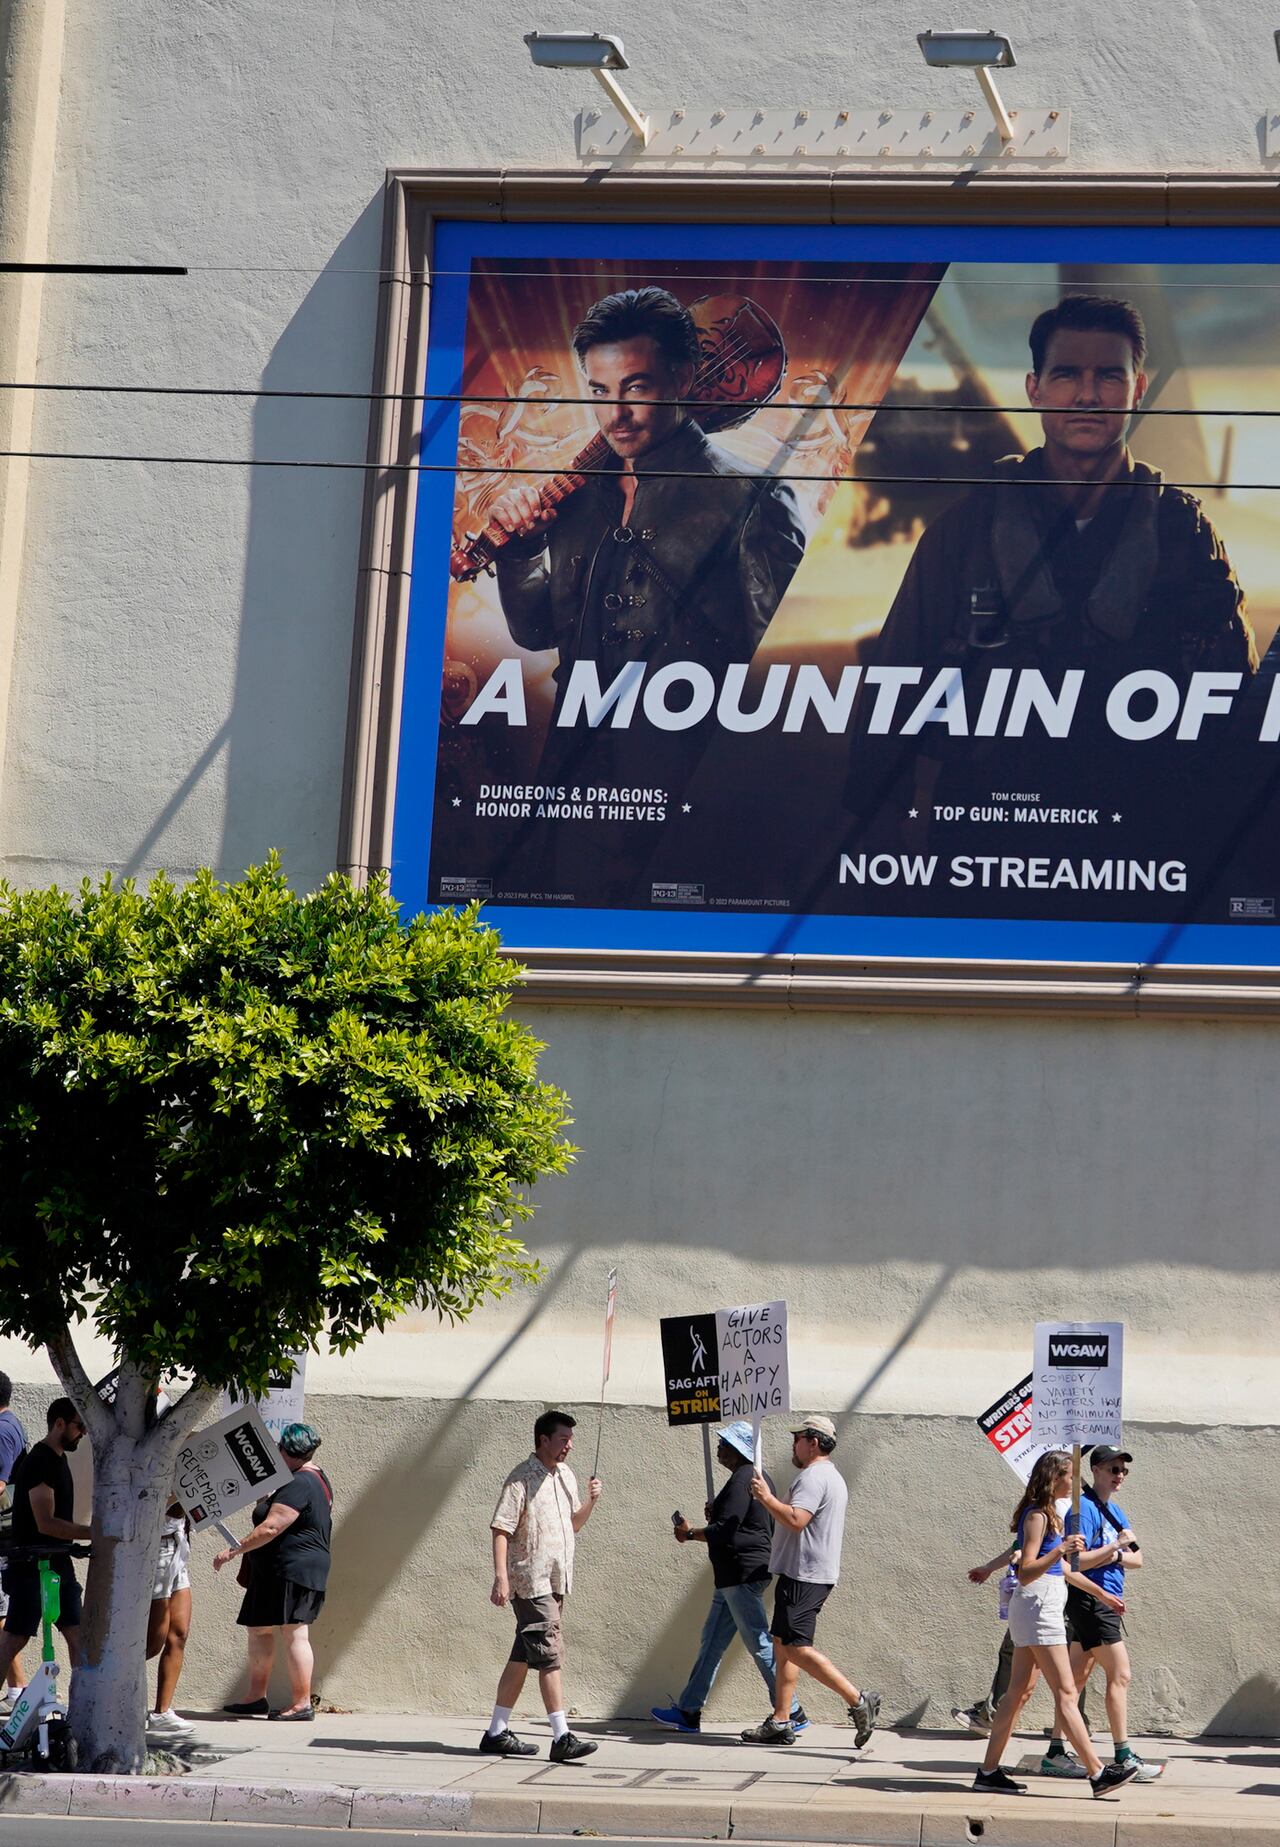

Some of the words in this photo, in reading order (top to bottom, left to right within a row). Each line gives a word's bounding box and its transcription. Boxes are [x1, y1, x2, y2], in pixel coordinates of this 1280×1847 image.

[459, 658, 528, 726] A
[556, 659, 1085, 739] MOUNTAIN
[1105, 669, 1242, 741] OF
[480, 785, 566, 801] DUNGEONS
[570, 787, 582, 801] &
[586, 787, 668, 804] DRAGONS:
[991, 792, 1010, 801] TOM
[1010, 792, 1041, 802] CRUISE
[475, 802, 531, 818] HONOR
[535, 804, 594, 820] AMONG
[598, 805, 666, 821] THIEVES
[933, 806, 965, 821] TOP
[969, 806, 1009, 823] GUN:
[1014, 807, 1099, 824] MAVERICK
[838, 853, 939, 886] NOW
[949, 855, 1187, 892] STREAMING
[441, 884, 465, 892] PG-13
[653, 889, 676, 898] PG-13
[1231, 902, 1244, 912] R
[728, 1307, 770, 1328] GIVE
[722, 1324, 782, 1351] ACTORS
[744, 1348, 756, 1365] A
[1051, 1344, 1107, 1357] WGAW
[669, 1375, 719, 1390] SAG·AFT
[721, 1364, 779, 1392] HAPPY
[695, 1390, 708, 1398] ON
[1047, 1386, 1096, 1398] VARIETY
[670, 1397, 720, 1415] STRIK
[722, 1387, 782, 1417] ENDING
[983, 1393, 1021, 1428] WRITERS
[1041, 1398, 1096, 1407] WRITERS
[1038, 1410, 1057, 1419] NO
[995, 1404, 1032, 1448] STRI
[1038, 1425, 1057, 1437] IN
[1062, 1423, 1121, 1440] STREAMING
[234, 1428, 268, 1478] WGAW
[177, 1447, 222, 1520] REMEMBER
[179, 1473, 199, 1498] US
[6, 1699, 30, 1736] Lime
